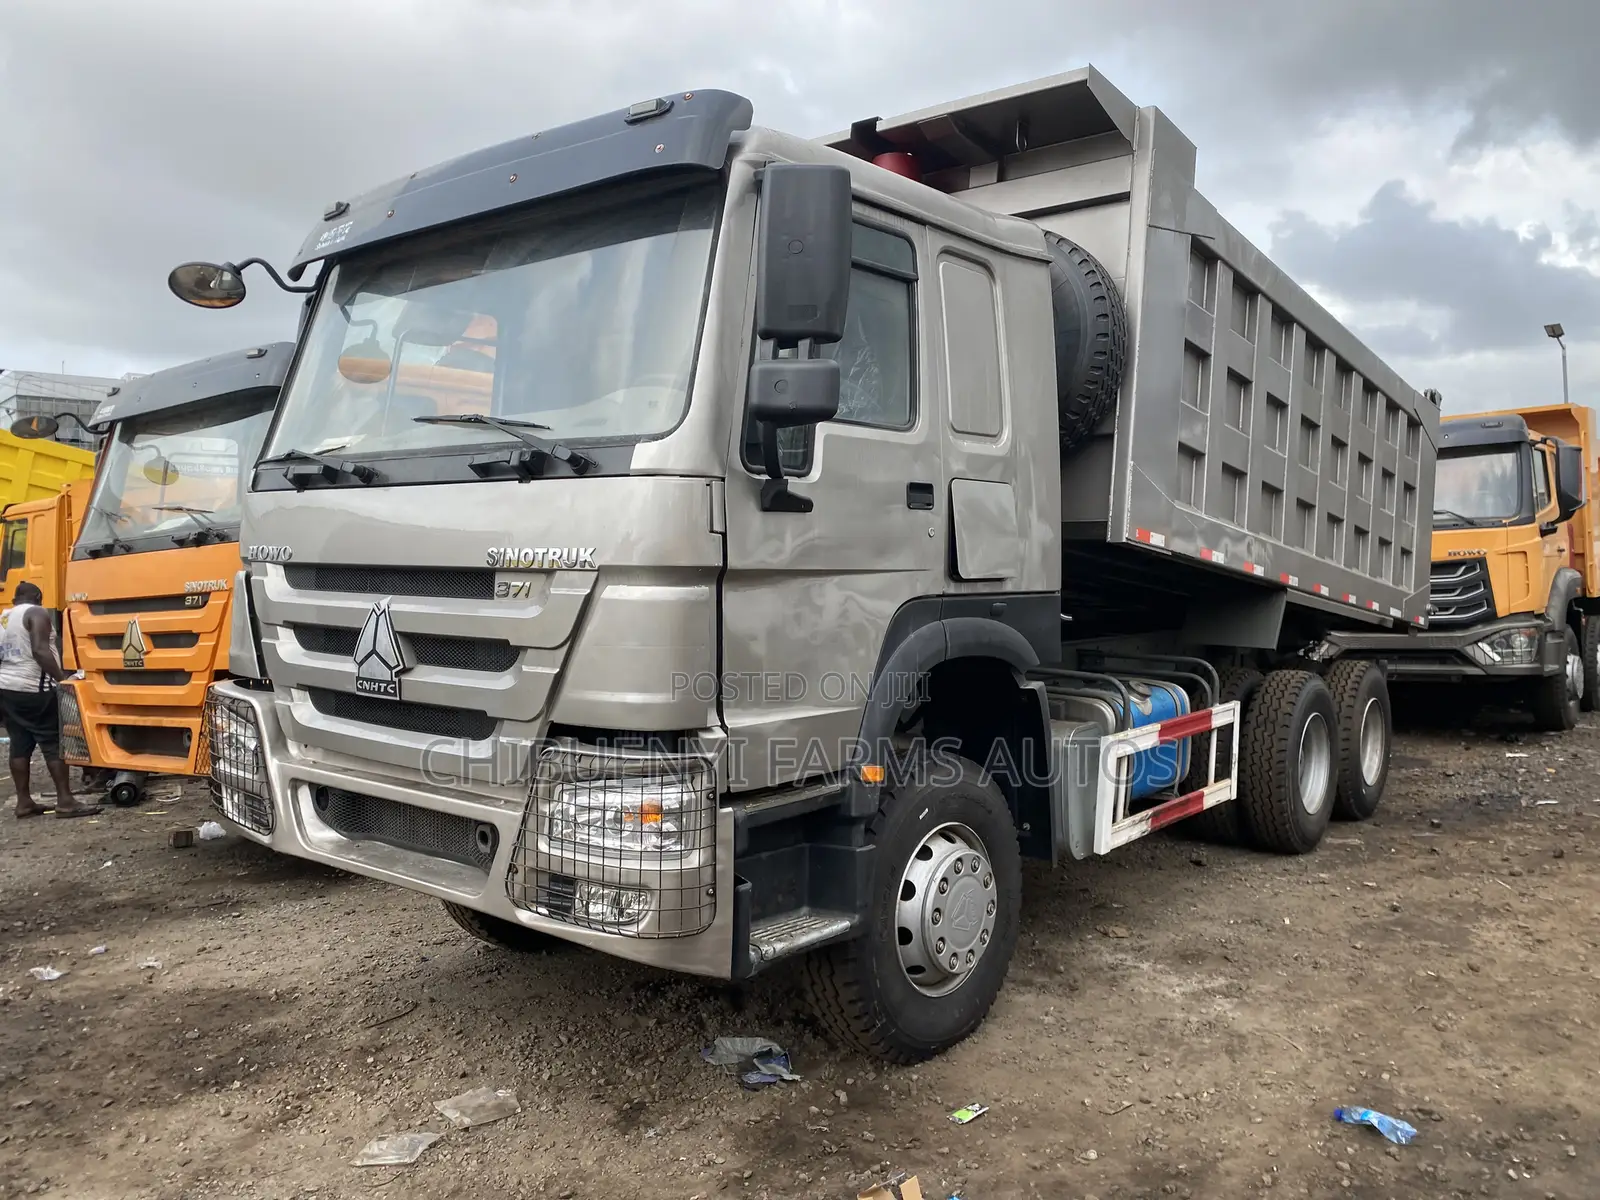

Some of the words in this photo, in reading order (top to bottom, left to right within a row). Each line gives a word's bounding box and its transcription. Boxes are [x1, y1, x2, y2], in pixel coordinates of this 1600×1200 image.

[248, 544, 293, 562] HOWO
[486, 546, 597, 568] SINOTRUK
[184, 579, 228, 593] SINOTRUK
[495, 581, 532, 599] 371
[184, 595, 202, 606] 371
[356, 680, 396, 694] CNHTC
